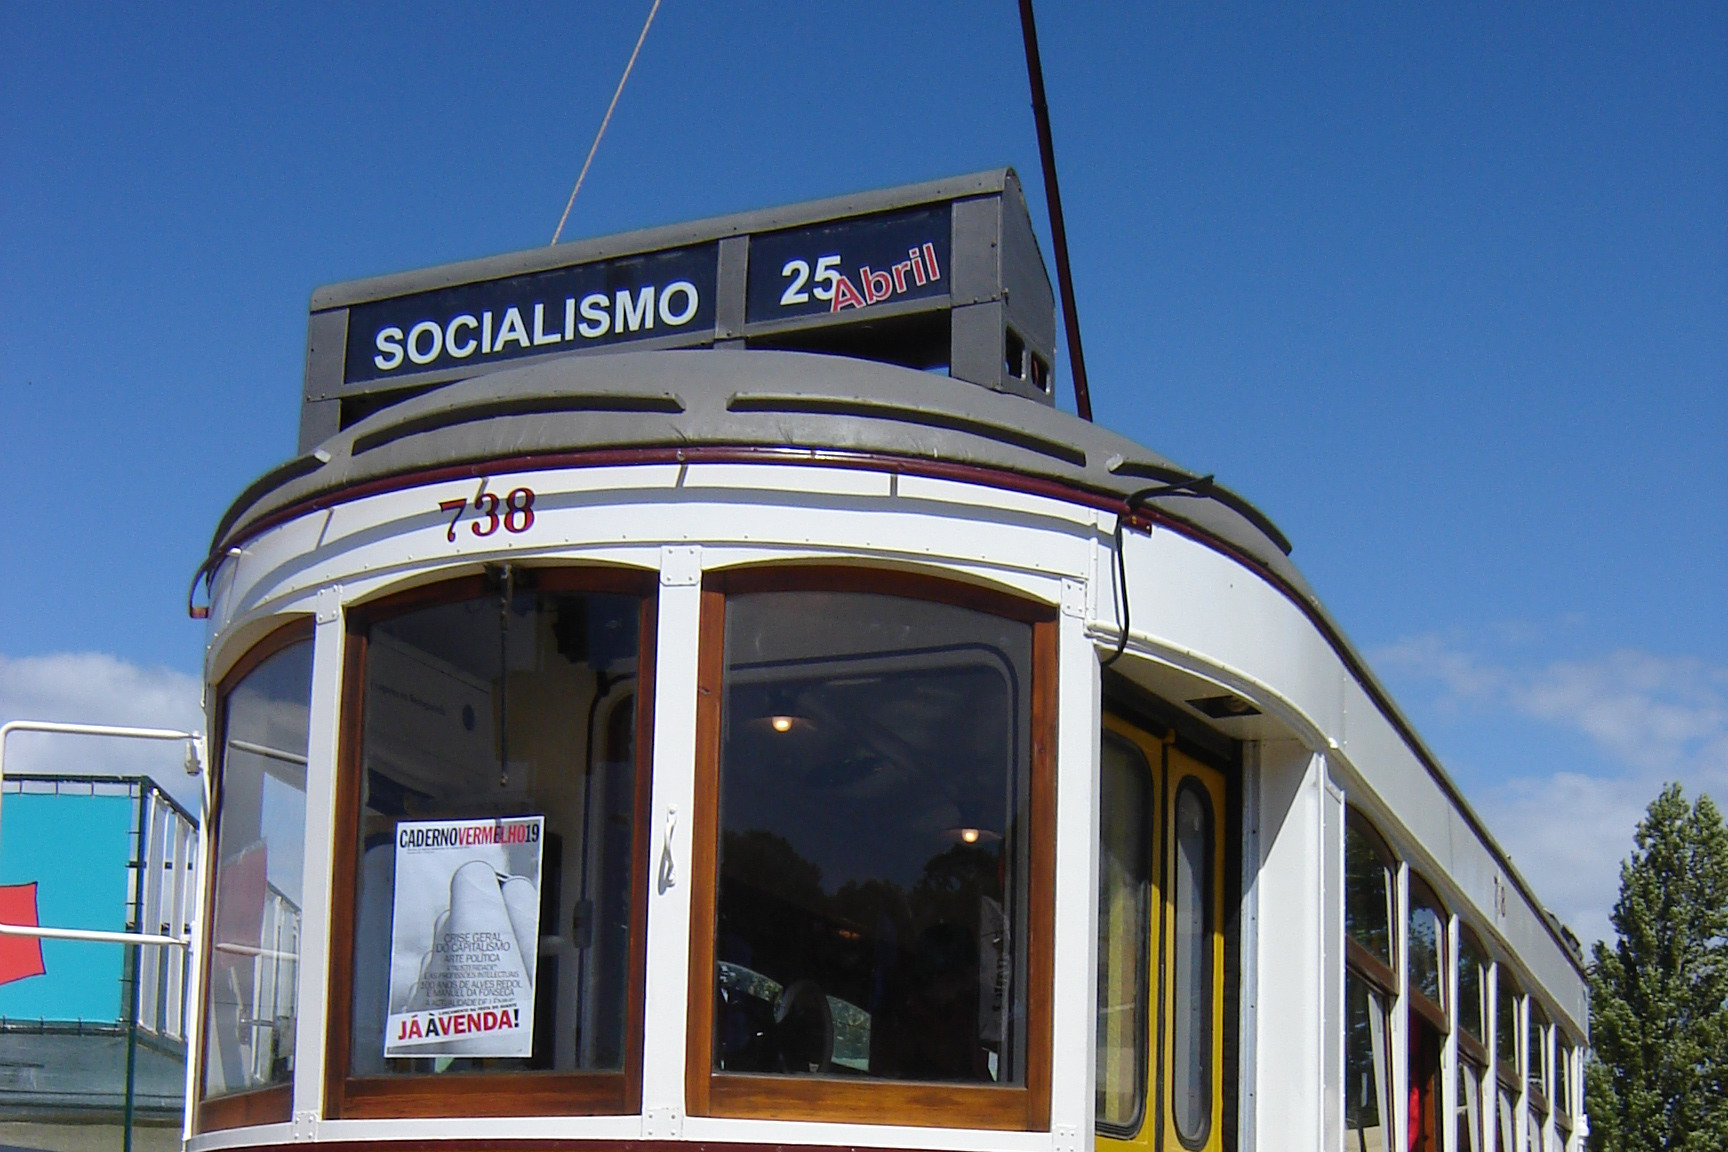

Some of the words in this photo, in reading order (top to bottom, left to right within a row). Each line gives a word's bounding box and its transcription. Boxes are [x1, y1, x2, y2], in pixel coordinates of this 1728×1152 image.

[779, 255, 841, 306] 25
[830, 242, 941, 313] Abril
[373, 280, 699, 371] SOCIALISMO
[438, 487, 536, 543] 738
[451, 941, 511, 953] CAPITALISMO
[472, 932, 502, 943] GERAL
[398, 1014, 423, 1040] JÁ
